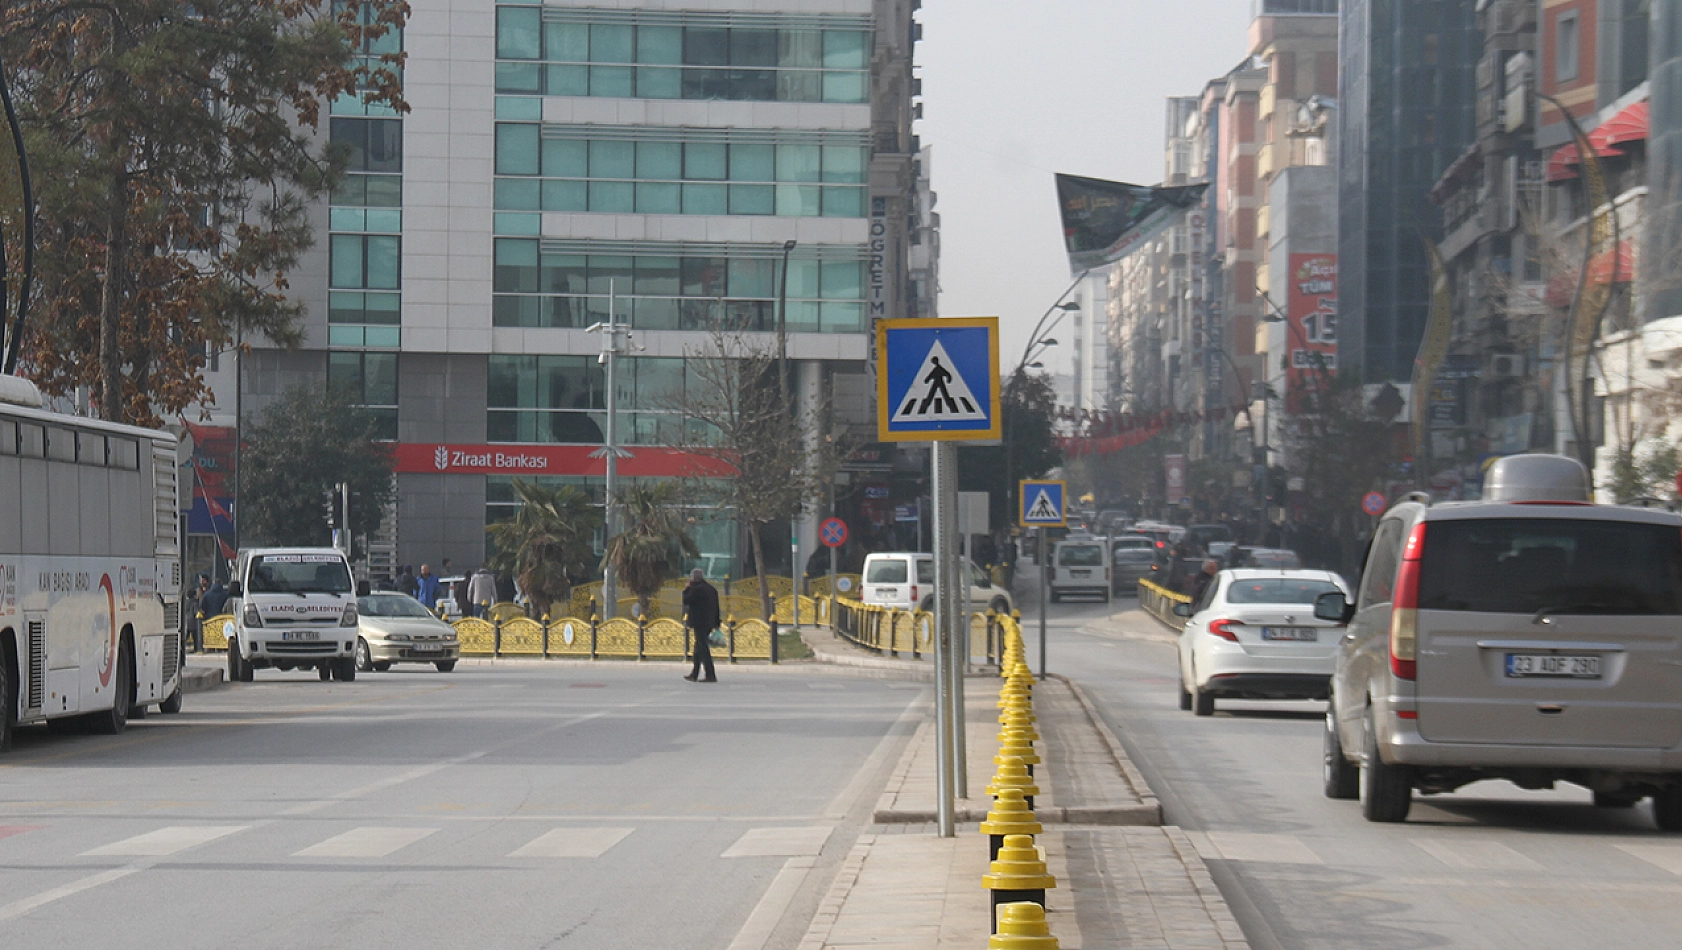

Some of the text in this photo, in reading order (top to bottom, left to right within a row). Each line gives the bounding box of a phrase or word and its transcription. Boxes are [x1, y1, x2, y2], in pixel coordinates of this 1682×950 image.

[1300, 280, 1334, 294] TÜM
[451, 451, 547, 468] Ziraat Bankası
[39, 568, 90, 598] KAN BAĞIŞI ARACI
[1515, 656, 1532, 672] 23
